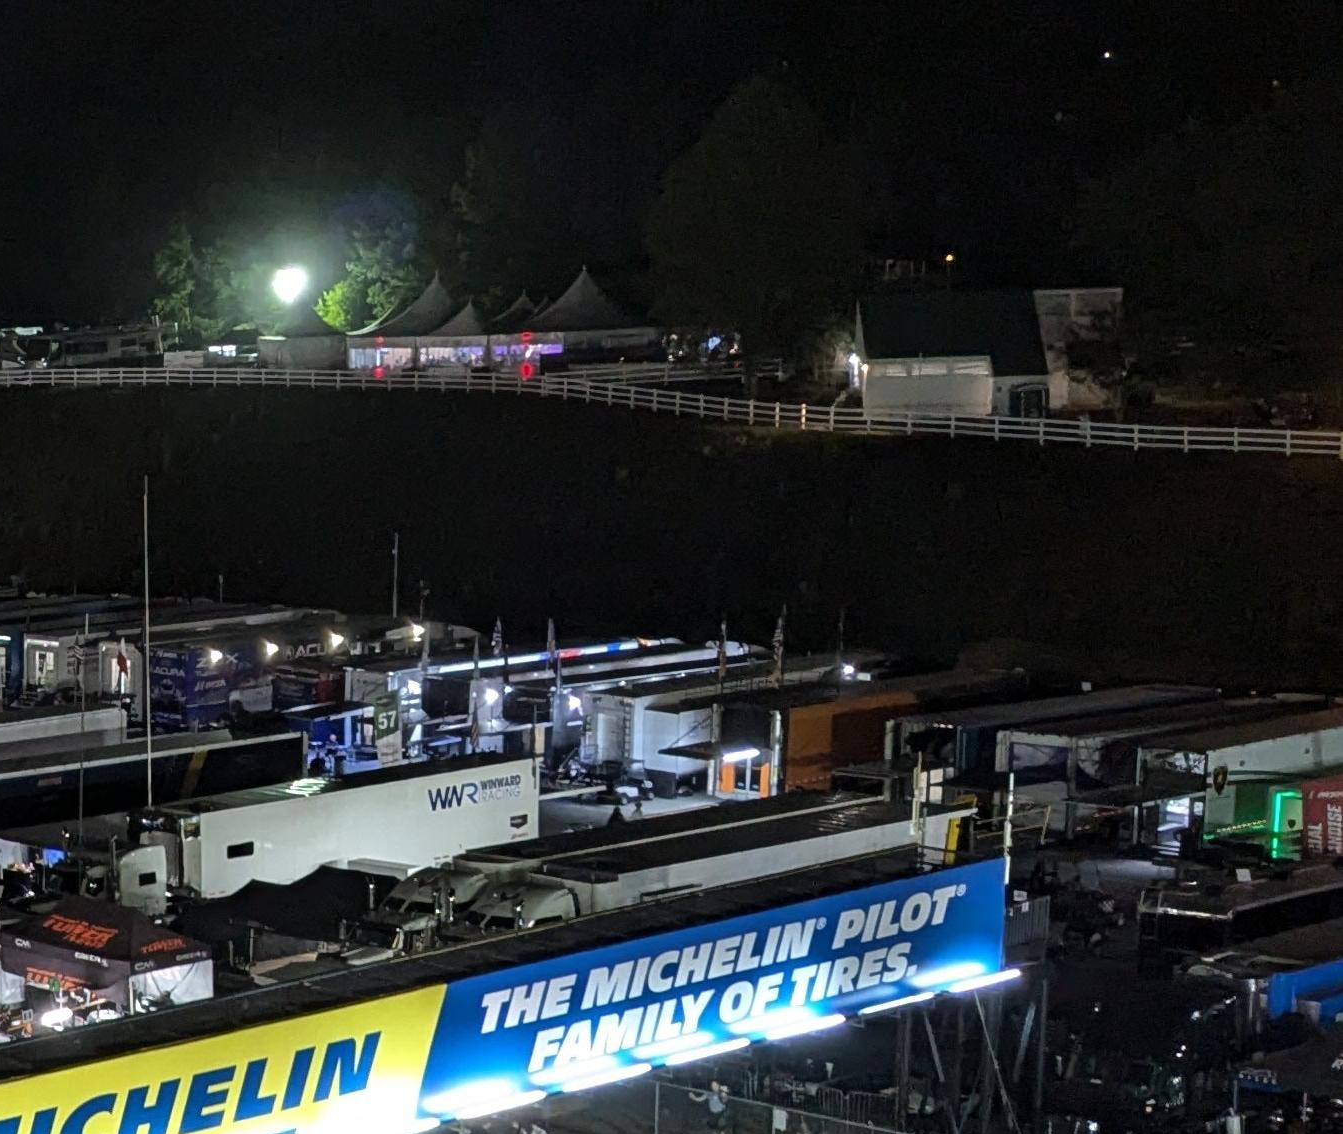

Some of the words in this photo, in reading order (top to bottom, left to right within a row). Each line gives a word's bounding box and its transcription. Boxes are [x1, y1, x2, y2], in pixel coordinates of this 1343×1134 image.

[378, 710, 397, 730] 57
[480, 774, 522, 790] WINWARD
[481, 787, 522, 801] RACING
[481, 973, 578, 1034] THE
[527, 990, 718, 1073] FAMILY
[718, 973, 782, 1024] OF
[790, 942, 919, 1008] TIRES.
